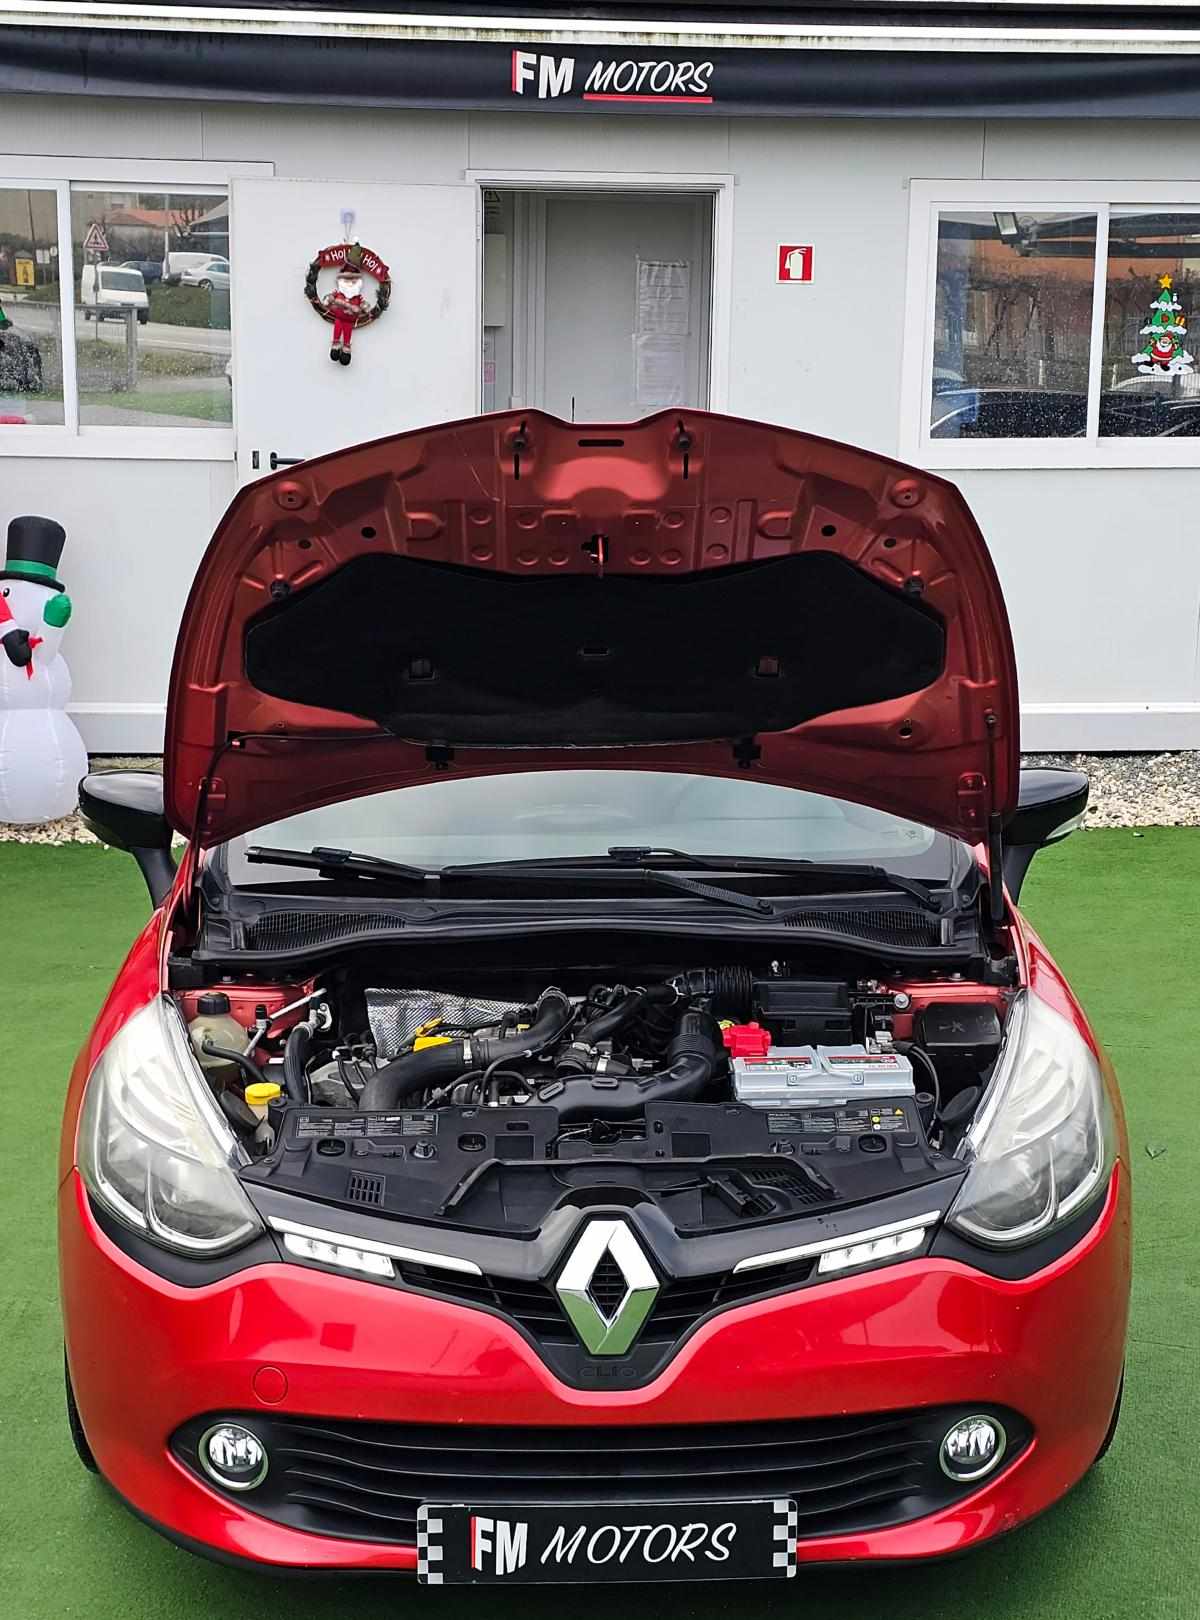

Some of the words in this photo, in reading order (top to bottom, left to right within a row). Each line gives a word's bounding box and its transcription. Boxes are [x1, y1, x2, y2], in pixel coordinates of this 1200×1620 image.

[515, 50, 575, 99] FM
[584, 60, 714, 93] MOTORS
[473, 1515, 528, 1576] FM
[540, 1522, 737, 1564] MOTORS
